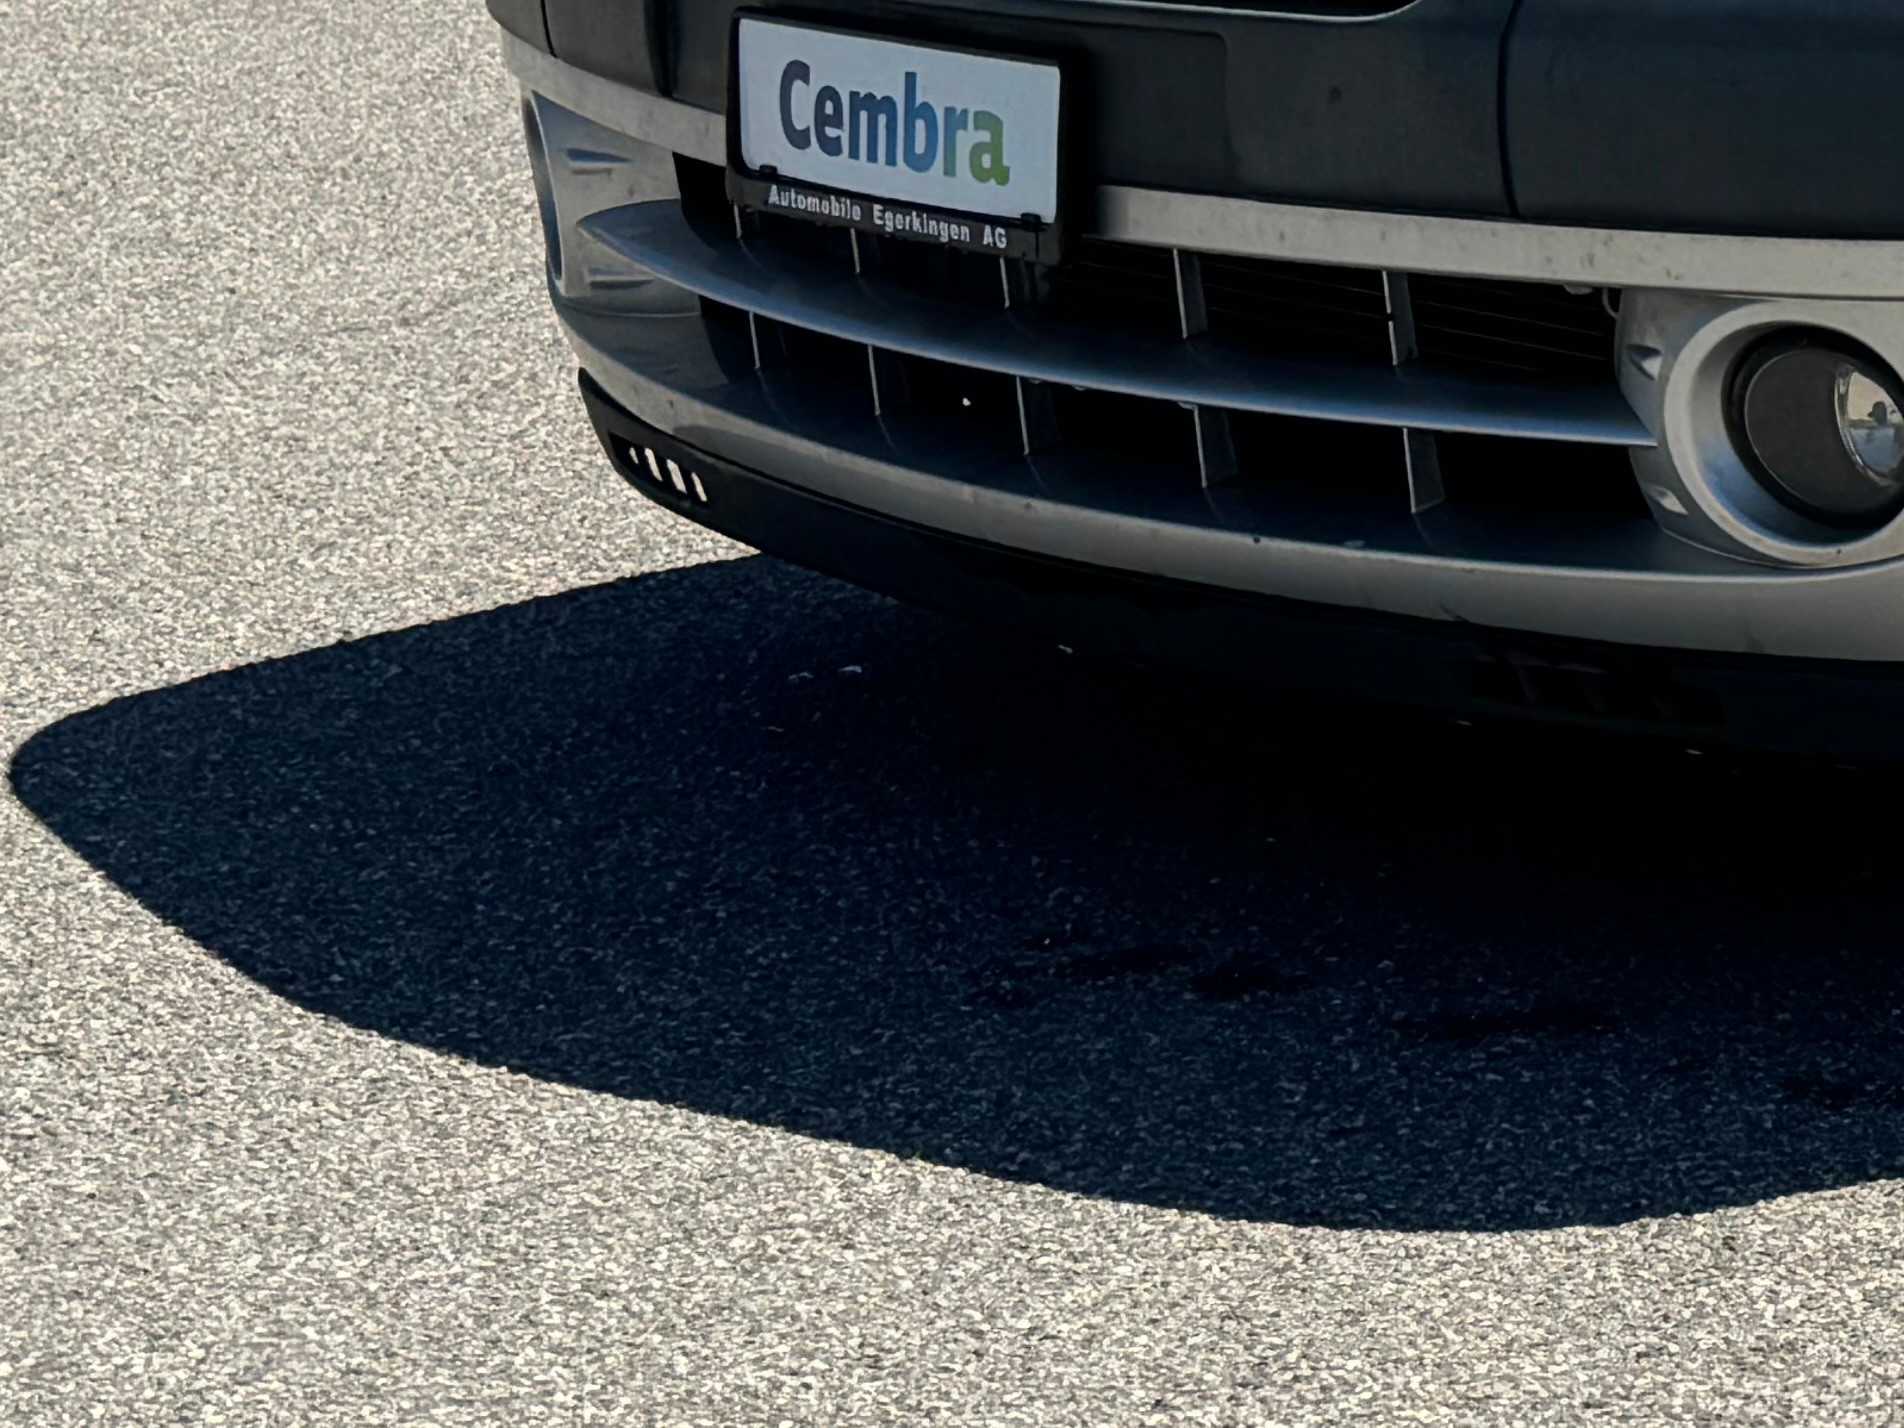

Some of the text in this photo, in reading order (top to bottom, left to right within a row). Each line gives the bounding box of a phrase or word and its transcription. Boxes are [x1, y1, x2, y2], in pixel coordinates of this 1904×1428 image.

[779, 59, 1011, 186] Cembra
[768, 184, 1008, 250] Automobile Egerkingen AG
